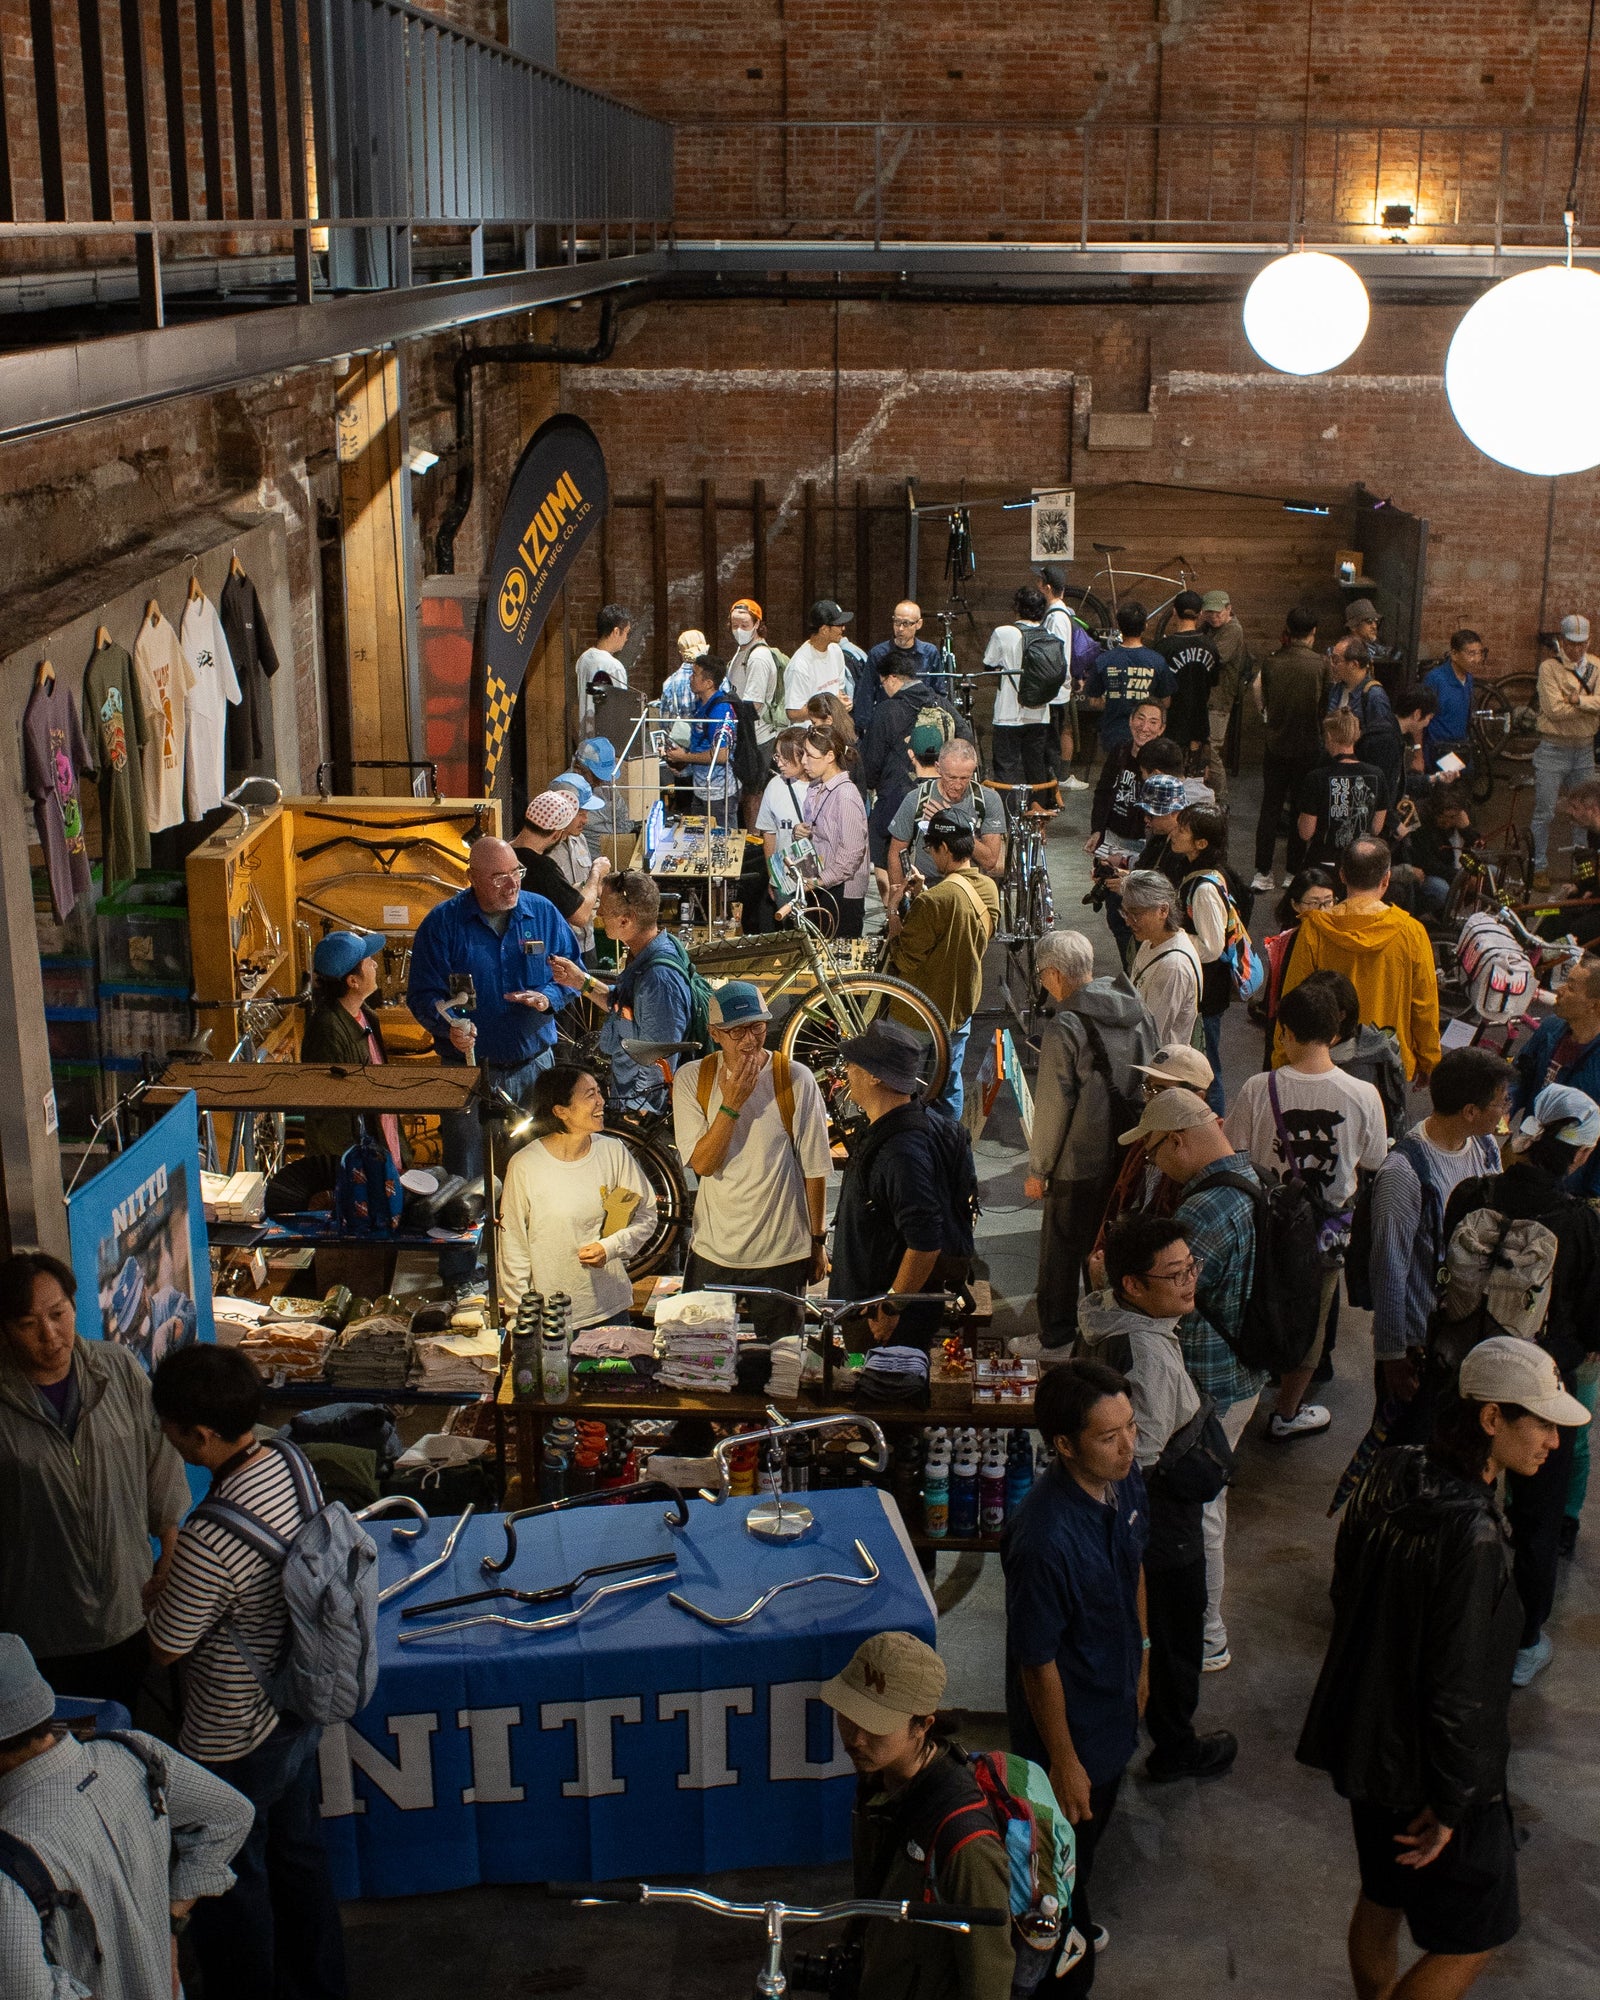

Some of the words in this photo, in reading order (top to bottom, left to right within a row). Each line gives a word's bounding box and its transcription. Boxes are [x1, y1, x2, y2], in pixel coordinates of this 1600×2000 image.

[518, 470, 583, 577] IZUMI
[516, 607, 533, 645] IZUMI
[530, 569, 549, 604] CHAIN
[547, 542, 565, 568] MFG.
[576, 502, 594, 521] LTD.
[1126, 678, 1152, 690] FIN
[1127, 666, 1155, 677] FIN
[111, 1162, 168, 1240] NITTO
[319, 1680, 858, 1819] NITTO
